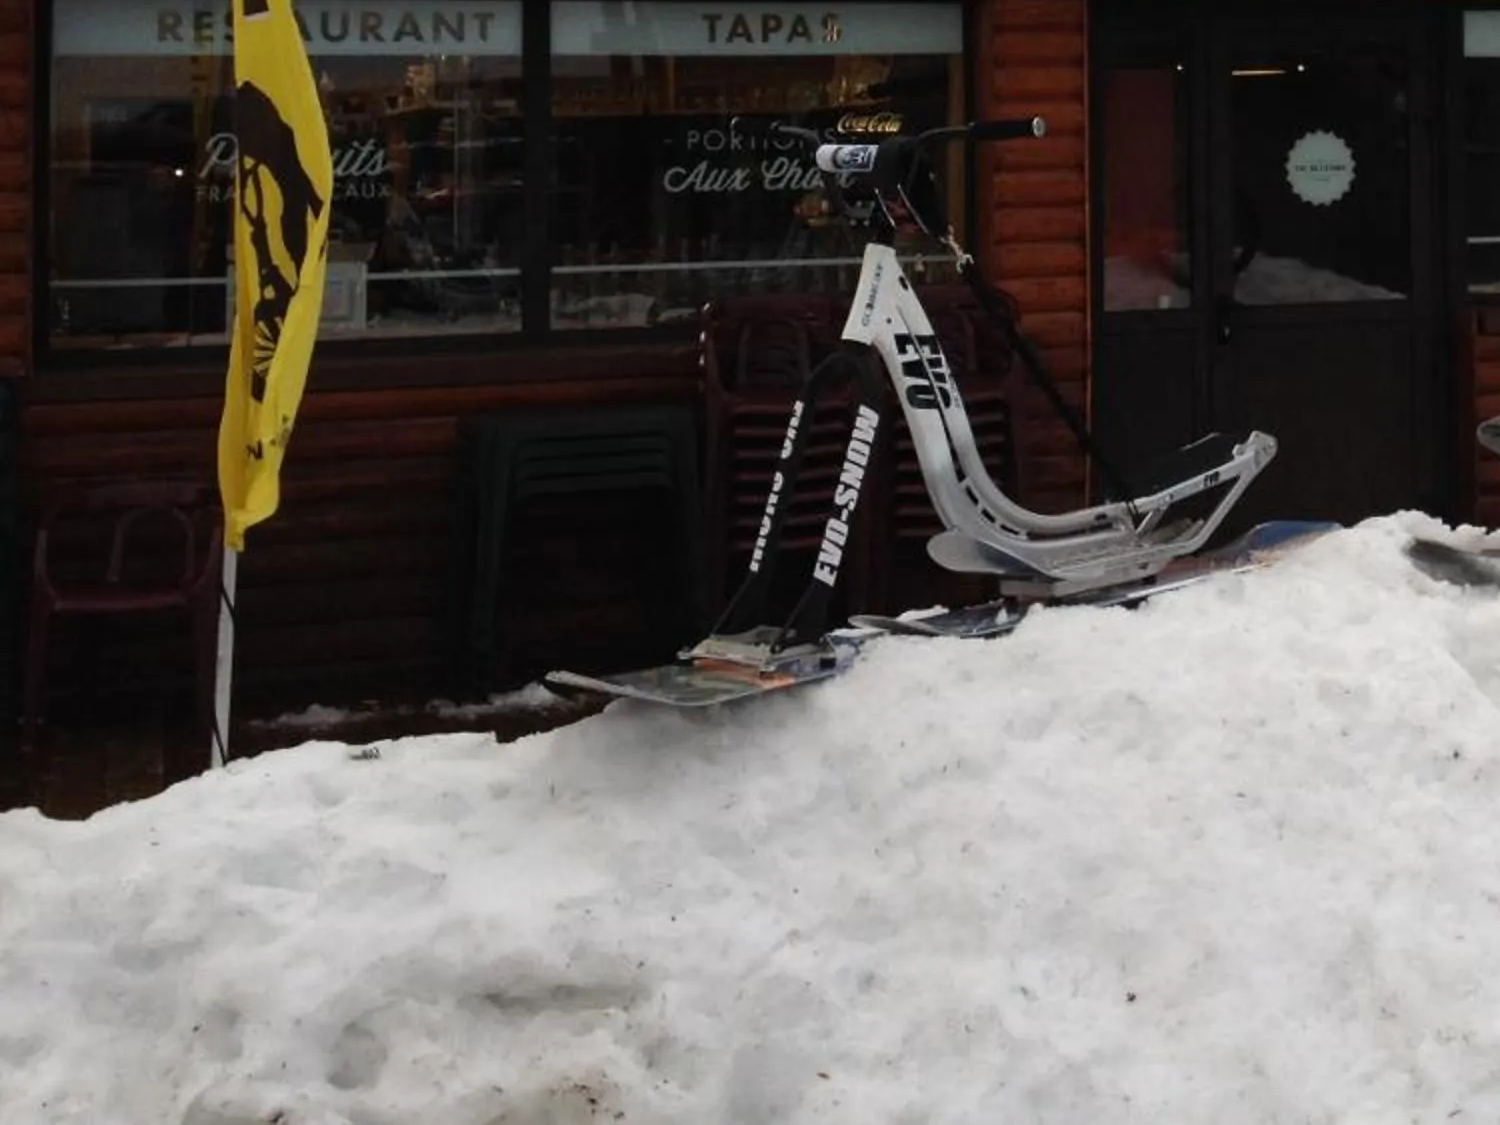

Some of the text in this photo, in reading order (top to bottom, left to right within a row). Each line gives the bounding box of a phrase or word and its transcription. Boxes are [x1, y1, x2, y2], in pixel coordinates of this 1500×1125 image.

[156, 9, 498, 44] REURANT
[662, 159, 752, 194] Aux
[812, 403, 881, 588] EVO-SNOW
